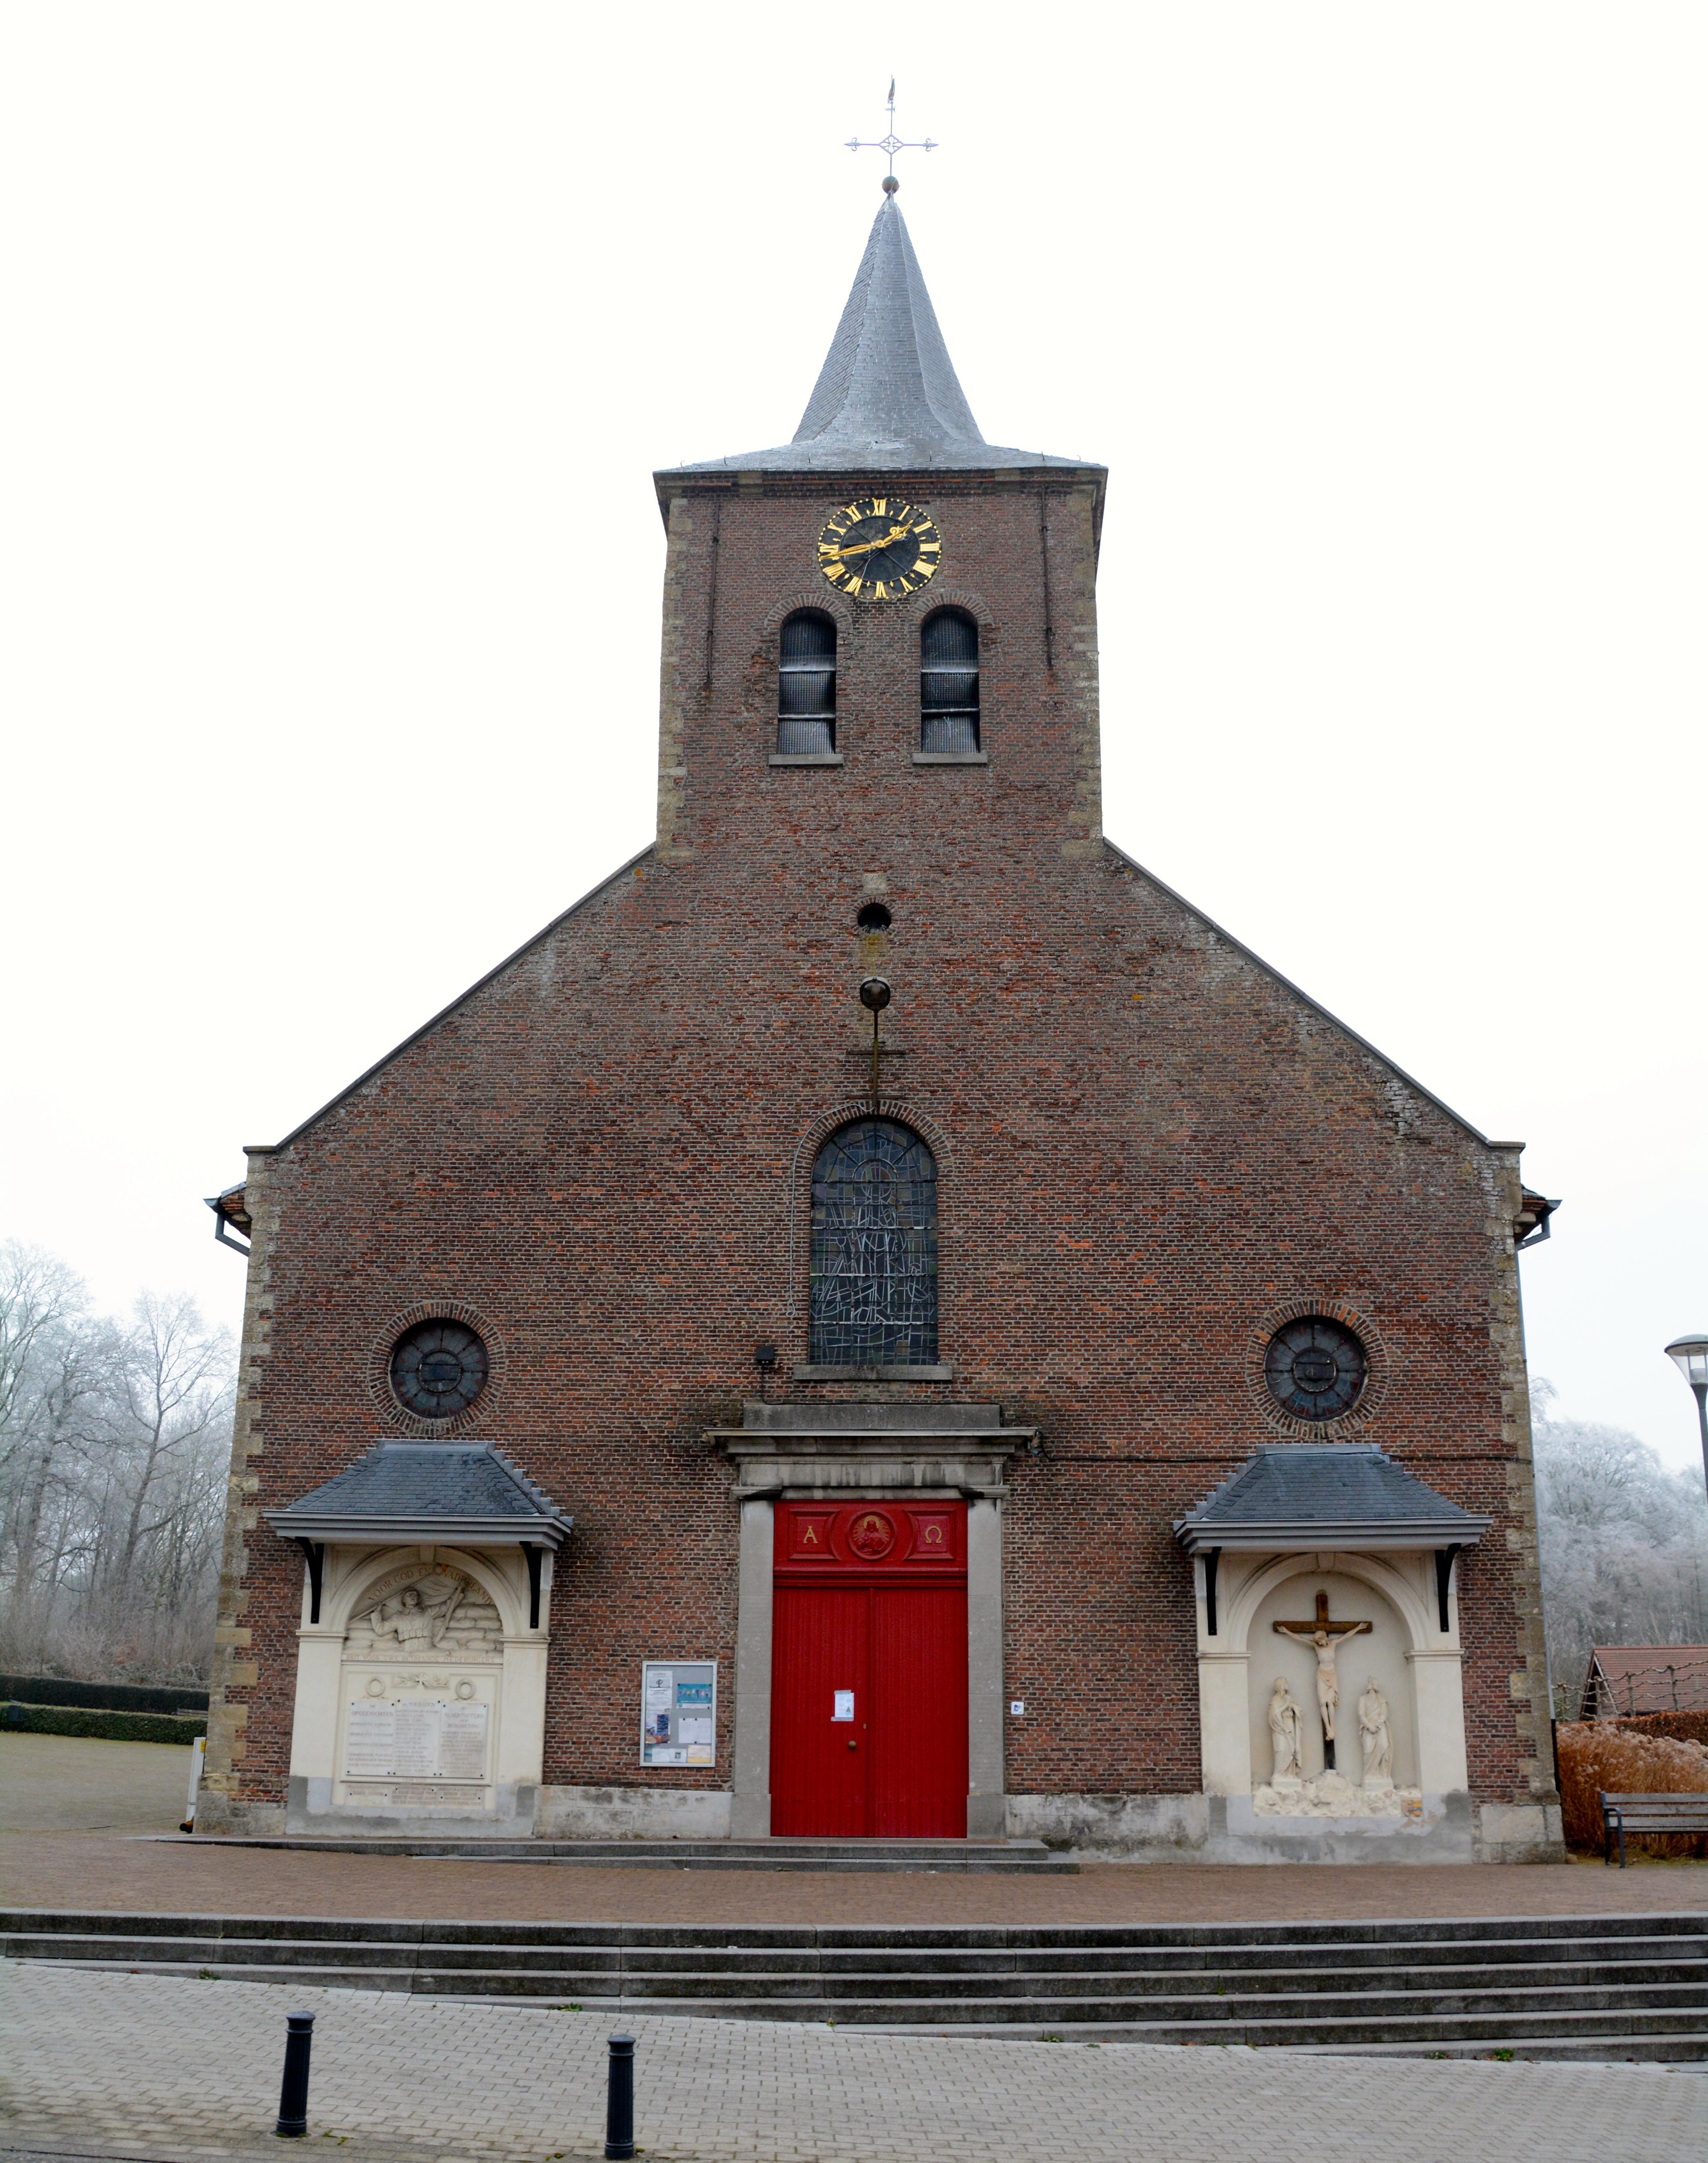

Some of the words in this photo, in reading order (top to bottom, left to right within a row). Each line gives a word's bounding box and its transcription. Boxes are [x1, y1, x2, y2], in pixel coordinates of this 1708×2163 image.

[845, 505, 863, 522] XI
[872, 498, 887, 516] XII
[898, 505, 911, 520] I
[827, 522, 847, 535] X
[913, 520, 933, 533] II
[920, 543, 941, 552] III
[822, 561, 846, 581] VIII
[913, 560, 937, 578] IIII
[843, 576, 863, 596] VII
[874, 581, 889, 600] VI
[900, 577, 914, 592] V
[925, 1525, 942, 1544] Ω
[368, 1580, 393, 1601] VOOR
[394, 1570, 413, 1583] GOD
[444, 1569, 491, 1604] VADLAND
